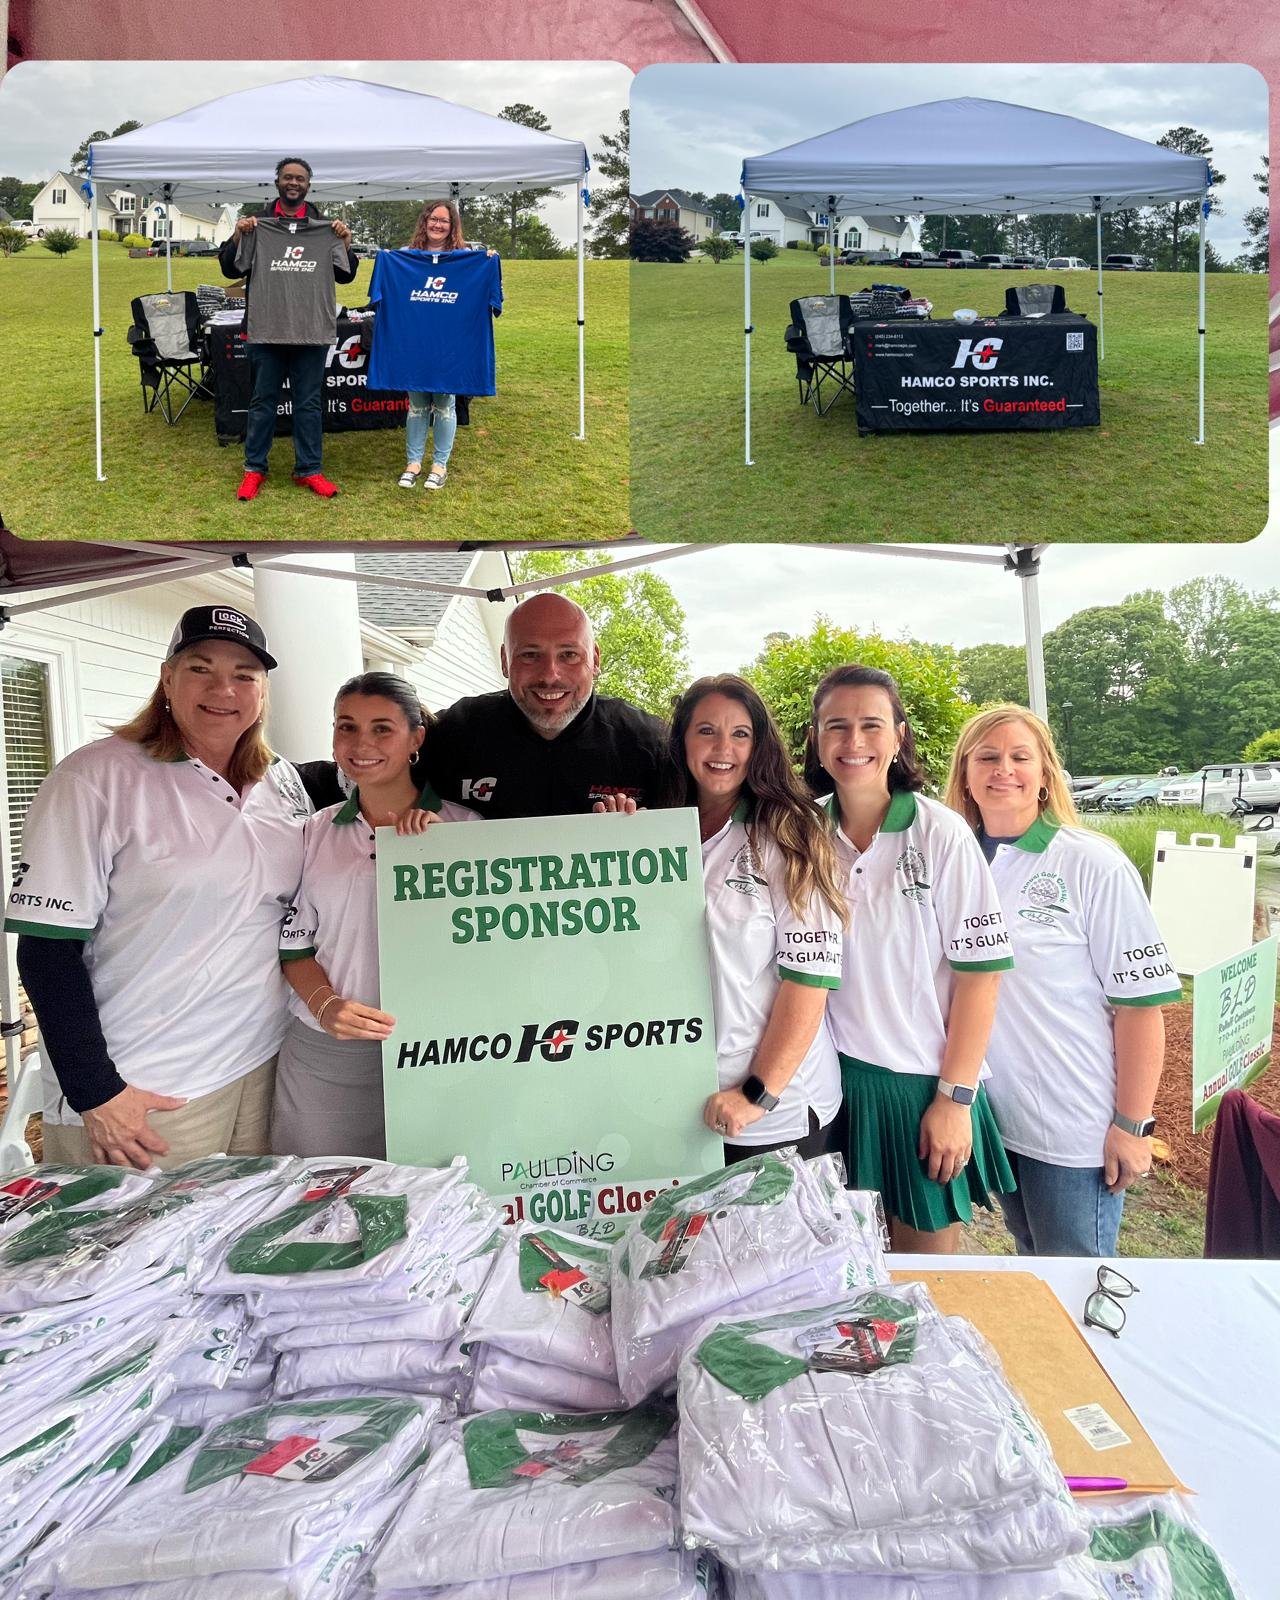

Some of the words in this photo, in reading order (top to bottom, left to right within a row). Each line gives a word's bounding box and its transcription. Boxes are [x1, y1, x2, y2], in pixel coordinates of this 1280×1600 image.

[271, 260, 317, 268] HAMCO
[411, 290, 459, 299] HAMCO
[326, 375, 367, 387] SPOR
[901, 376, 956, 388] HAMCO
[960, 375, 1019, 388] SPORTS
[1024, 375, 1054, 387] INC.
[328, 399, 347, 413] It's
[351, 397, 411, 413] Guarant
[889, 399, 956, 414] Together...
[961, 399, 979, 412] It's
[983, 398, 1066, 412] Guaranteed
[208, 625, 250, 639] PERFECTION
[392, 846, 688, 901] REGISTRATION
[10, 893, 43, 907] ORTS
[45, 897, 74, 912] INC.
[451, 896, 641, 944] SPONSOR
[963, 912, 1002, 930] TOGET
[282, 928, 306, 939] ORTS
[950, 937, 973, 951] IT'S
[1123, 942, 1168, 962] TOGET
[1220, 952, 1257, 984] WELCOME
[1113, 970, 1140, 984] IT'S
[397, 1033, 512, 1069] HAMCO
[584, 1017, 703, 1052] SPORTS
[1202, 1068, 1228, 1102] Annual
[1228, 1056, 1243, 1081] GOLF
[1243, 1041, 1265, 1068] Classic
[501, 1152, 615, 1181] PAULDING
[520, 1182, 550, 1190] Chamber
[560, 1177, 597, 1186] Commerce
[529, 1189, 592, 1223] GOLF
